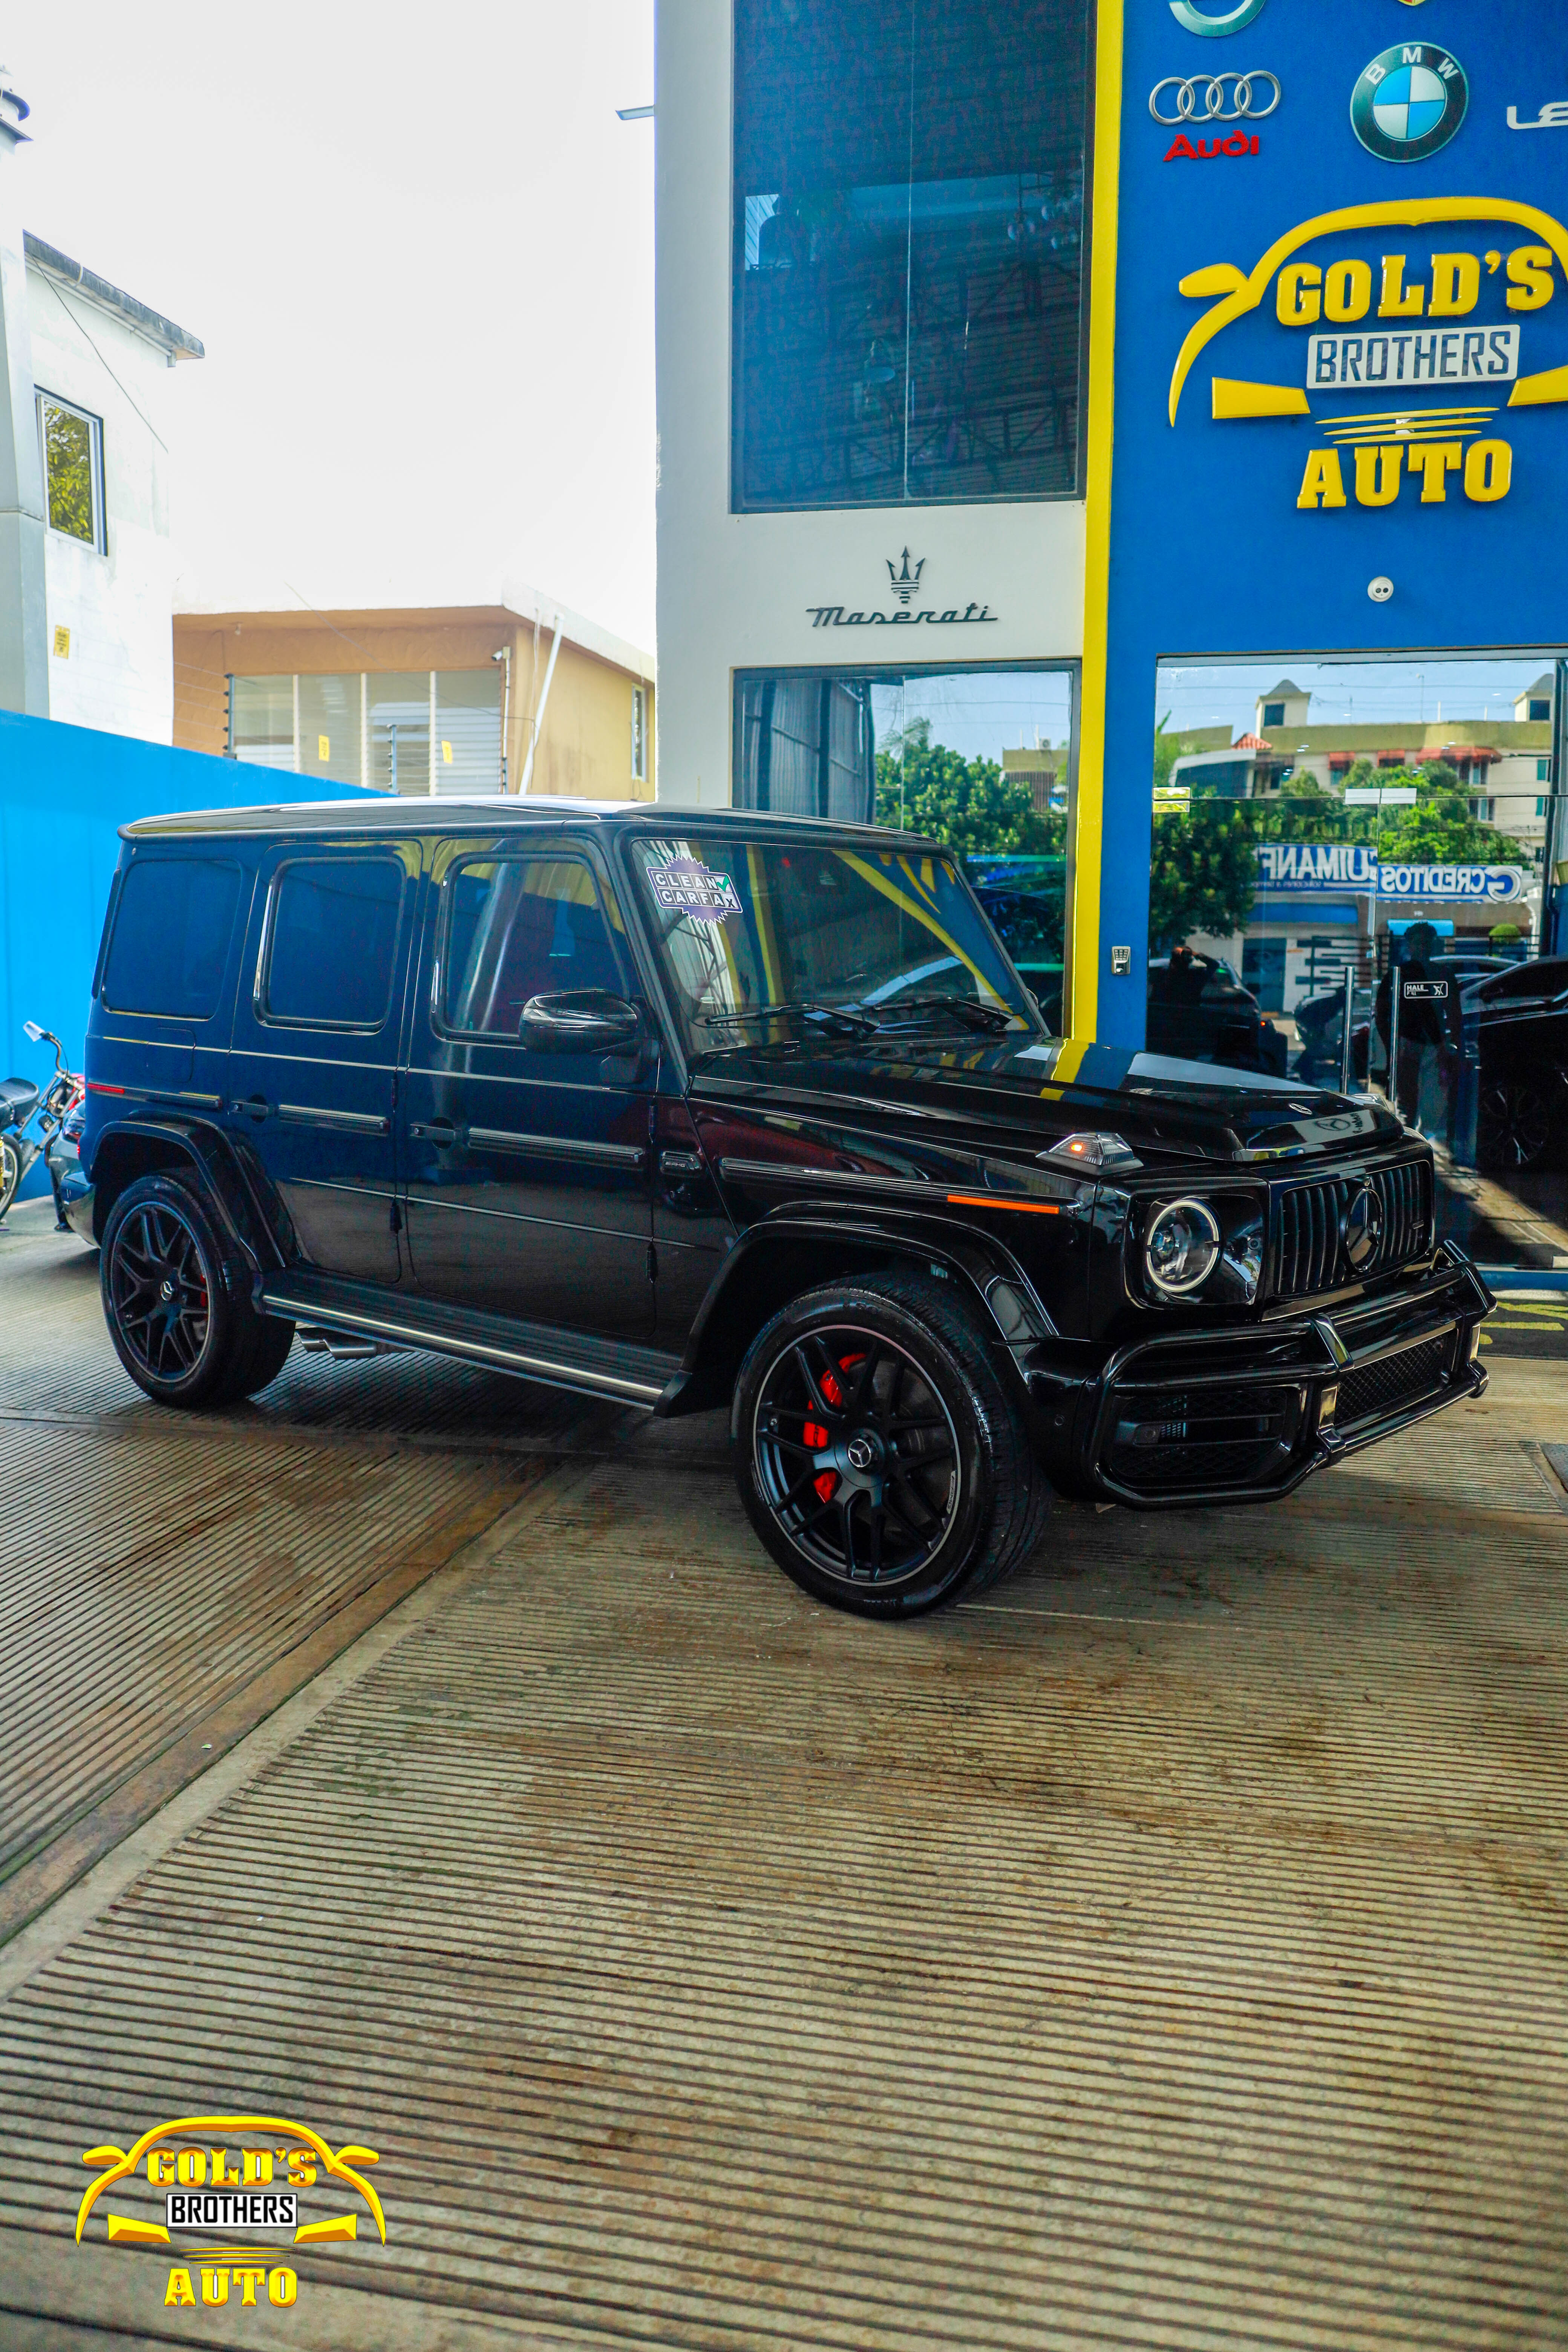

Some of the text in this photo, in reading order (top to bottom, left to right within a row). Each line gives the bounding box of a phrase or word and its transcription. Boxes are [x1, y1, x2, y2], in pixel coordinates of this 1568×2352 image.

[1365, 46, 1459, 85] BMW
[1163, 130, 1260, 162] Audi
[1276, 246, 1554, 326] GOLD'S
[1315, 330, 1511, 383] BROTHERS
[1297, 439, 1513, 508] AUTO
[805, 602, 998, 627] Maserati
[655, 873, 718, 889] CLEAN
[662, 890, 735, 908] CARFAX
